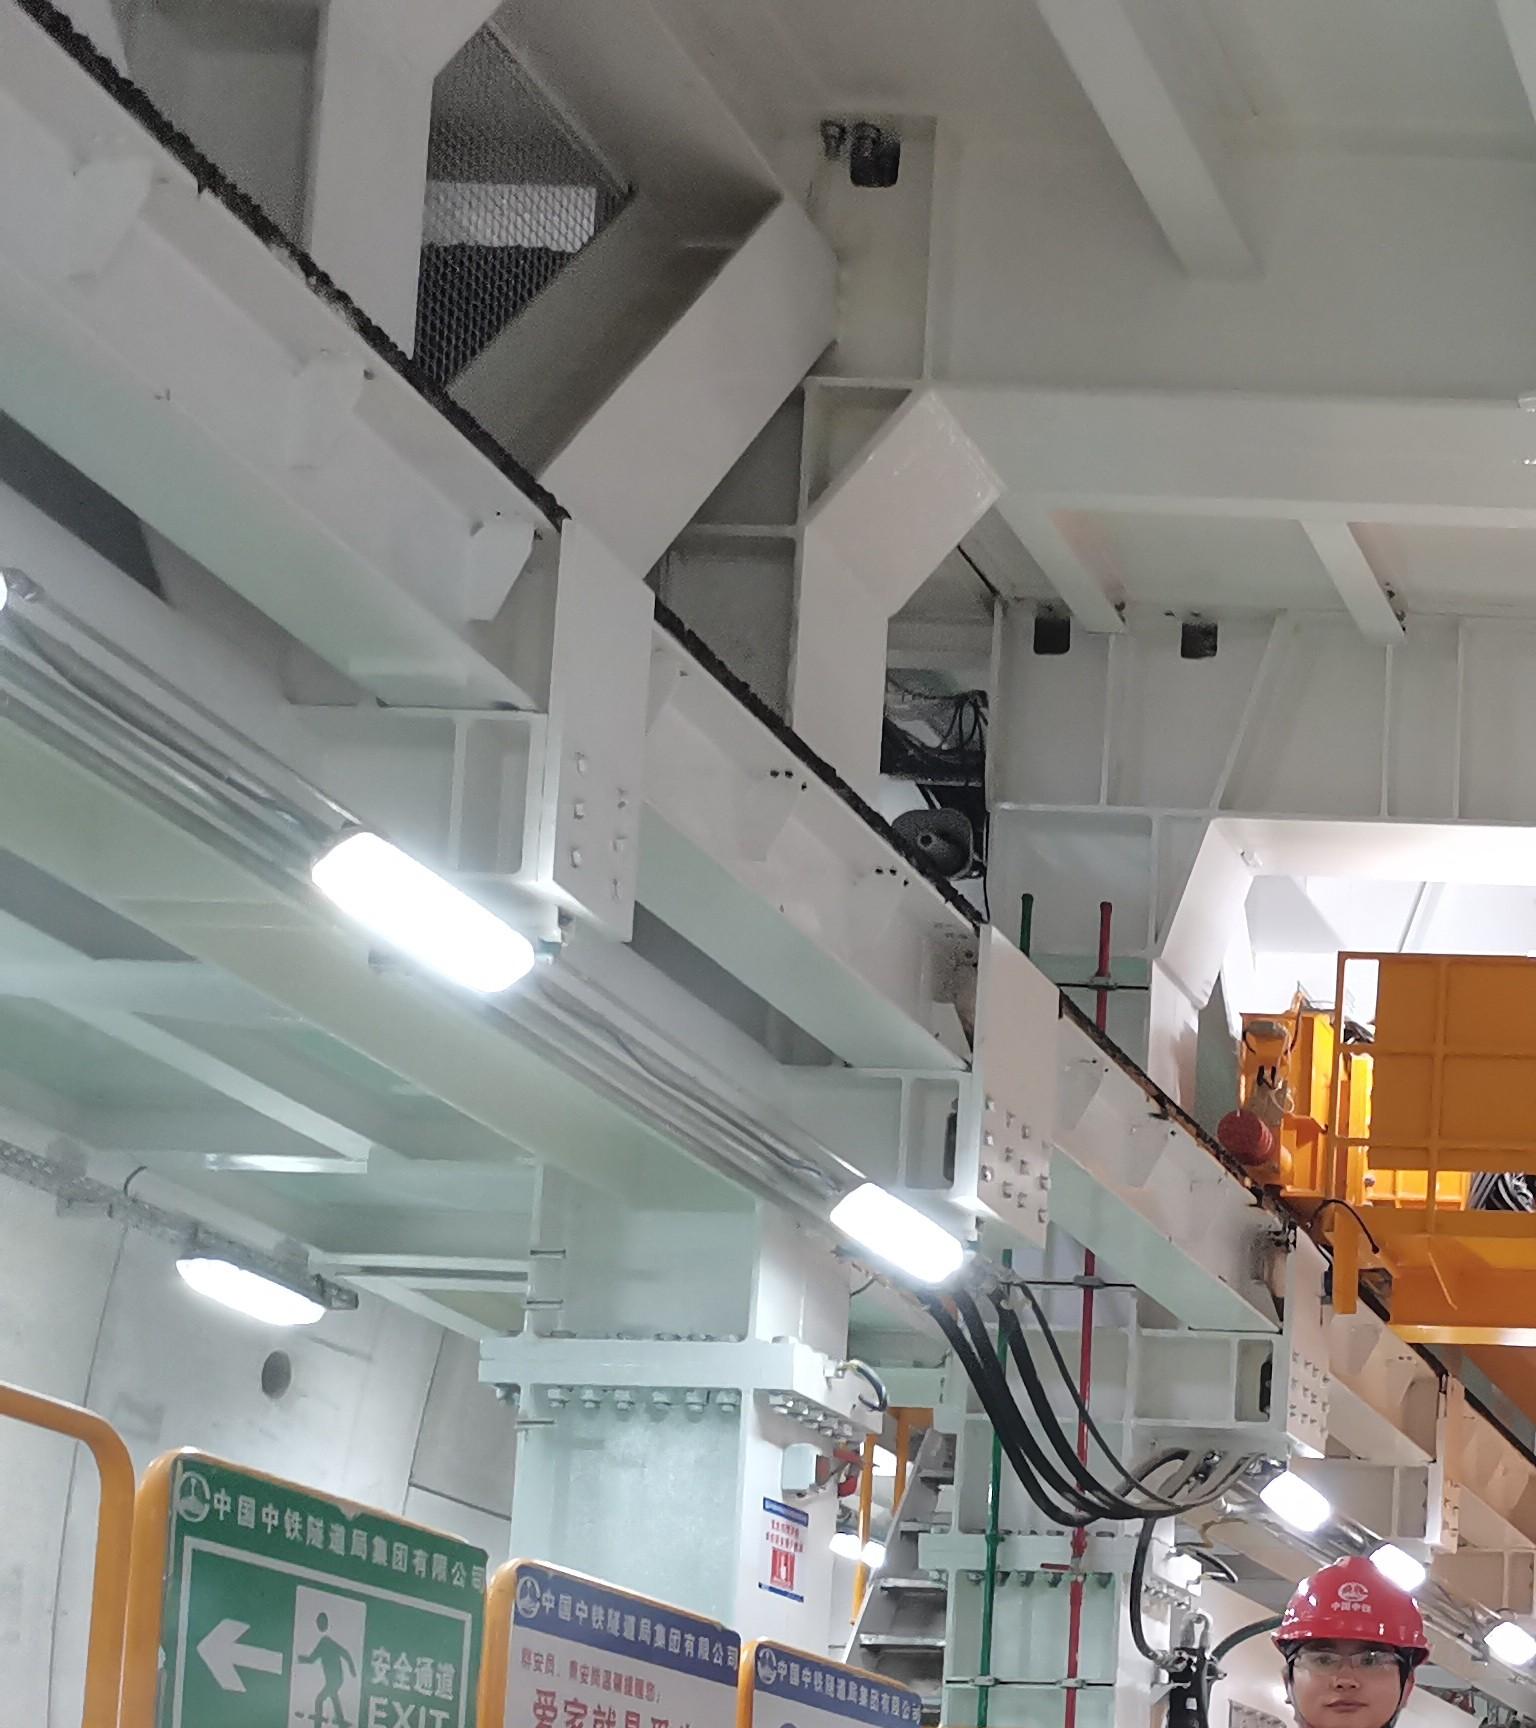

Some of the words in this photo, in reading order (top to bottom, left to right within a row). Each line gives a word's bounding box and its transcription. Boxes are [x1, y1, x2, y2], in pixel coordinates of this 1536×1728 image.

[212, 1487, 486, 1593] 中国中铁隧道局集团有限公司
[541, 1587, 739, 1673] 中国中铁隧道局集团有限公司
[370, 1646, 455, 1701] 安全通道
